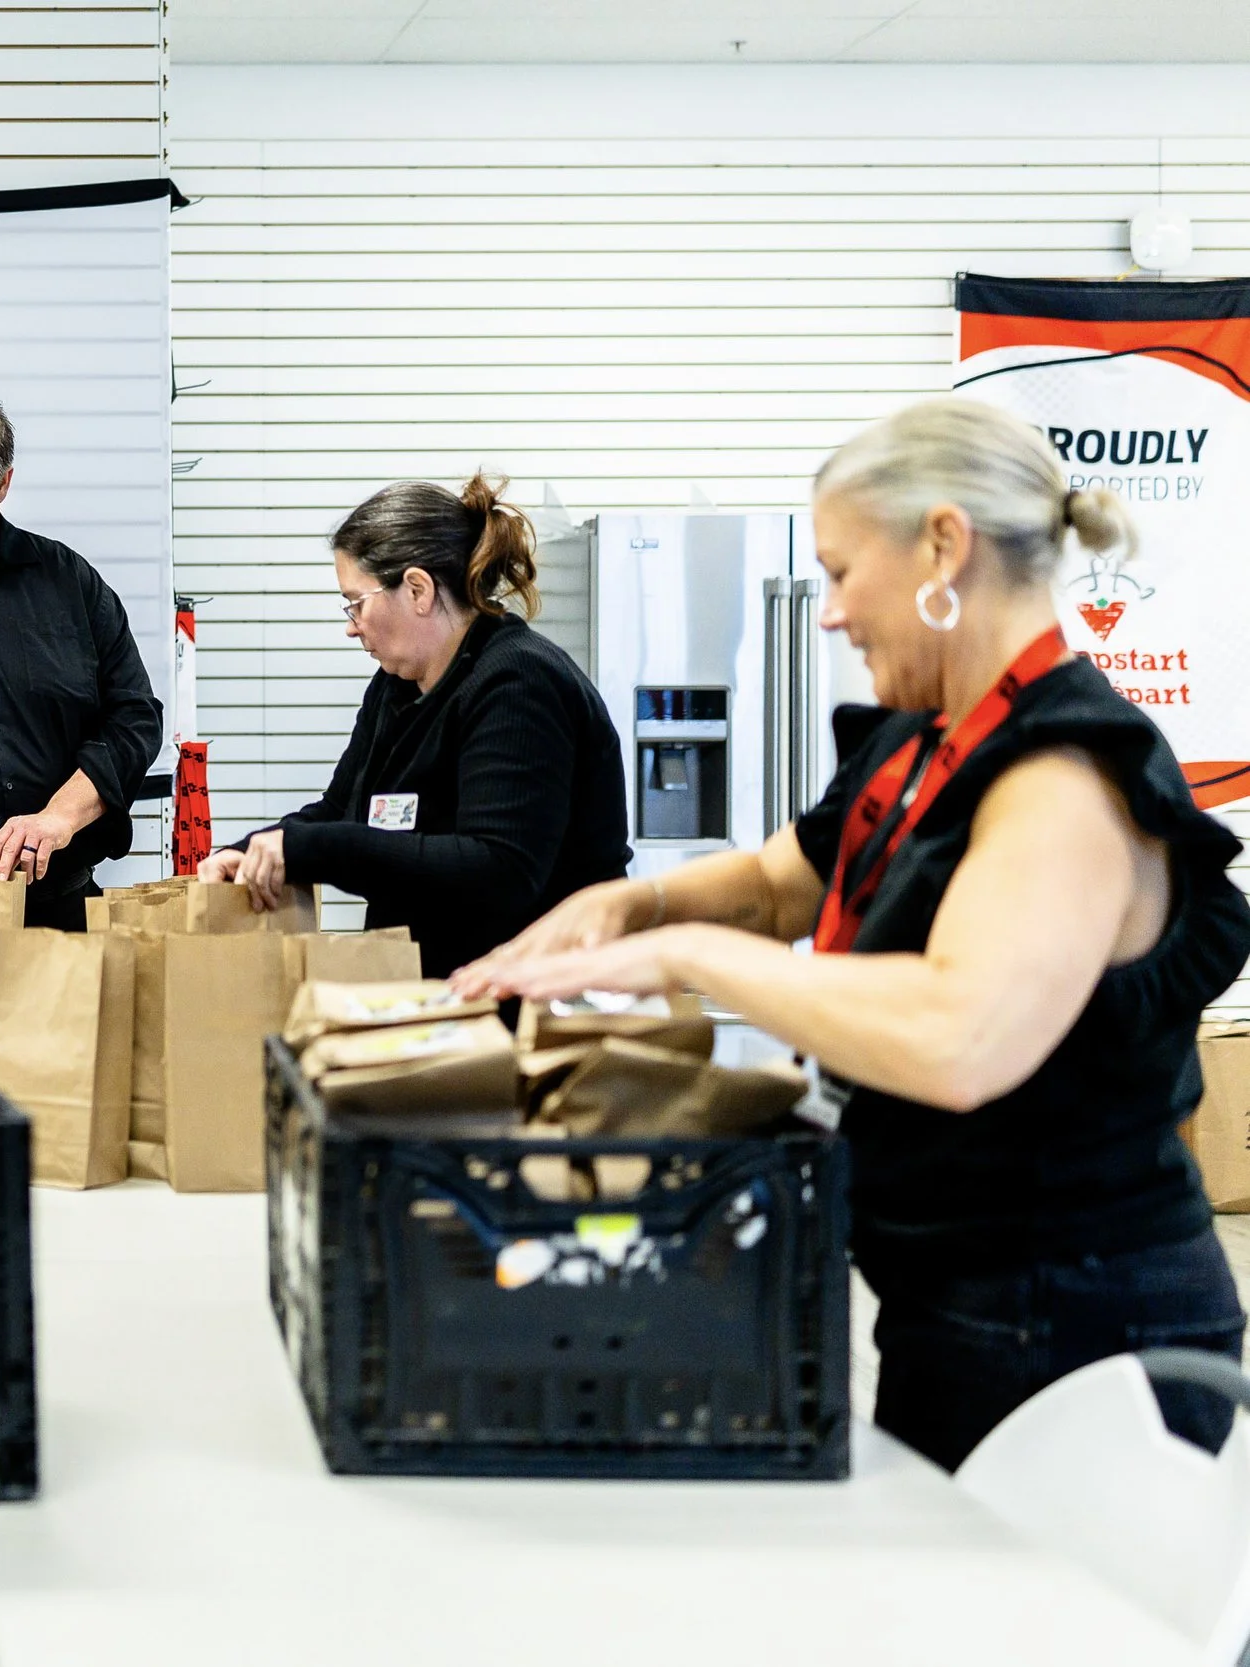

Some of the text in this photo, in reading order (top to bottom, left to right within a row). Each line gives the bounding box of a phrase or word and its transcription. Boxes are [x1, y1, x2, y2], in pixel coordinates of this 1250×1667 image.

[1048, 427, 1209, 465] ROUDLY
[1069, 474, 1204, 501] PORTED BY
[1091, 649, 1189, 671] pstart
